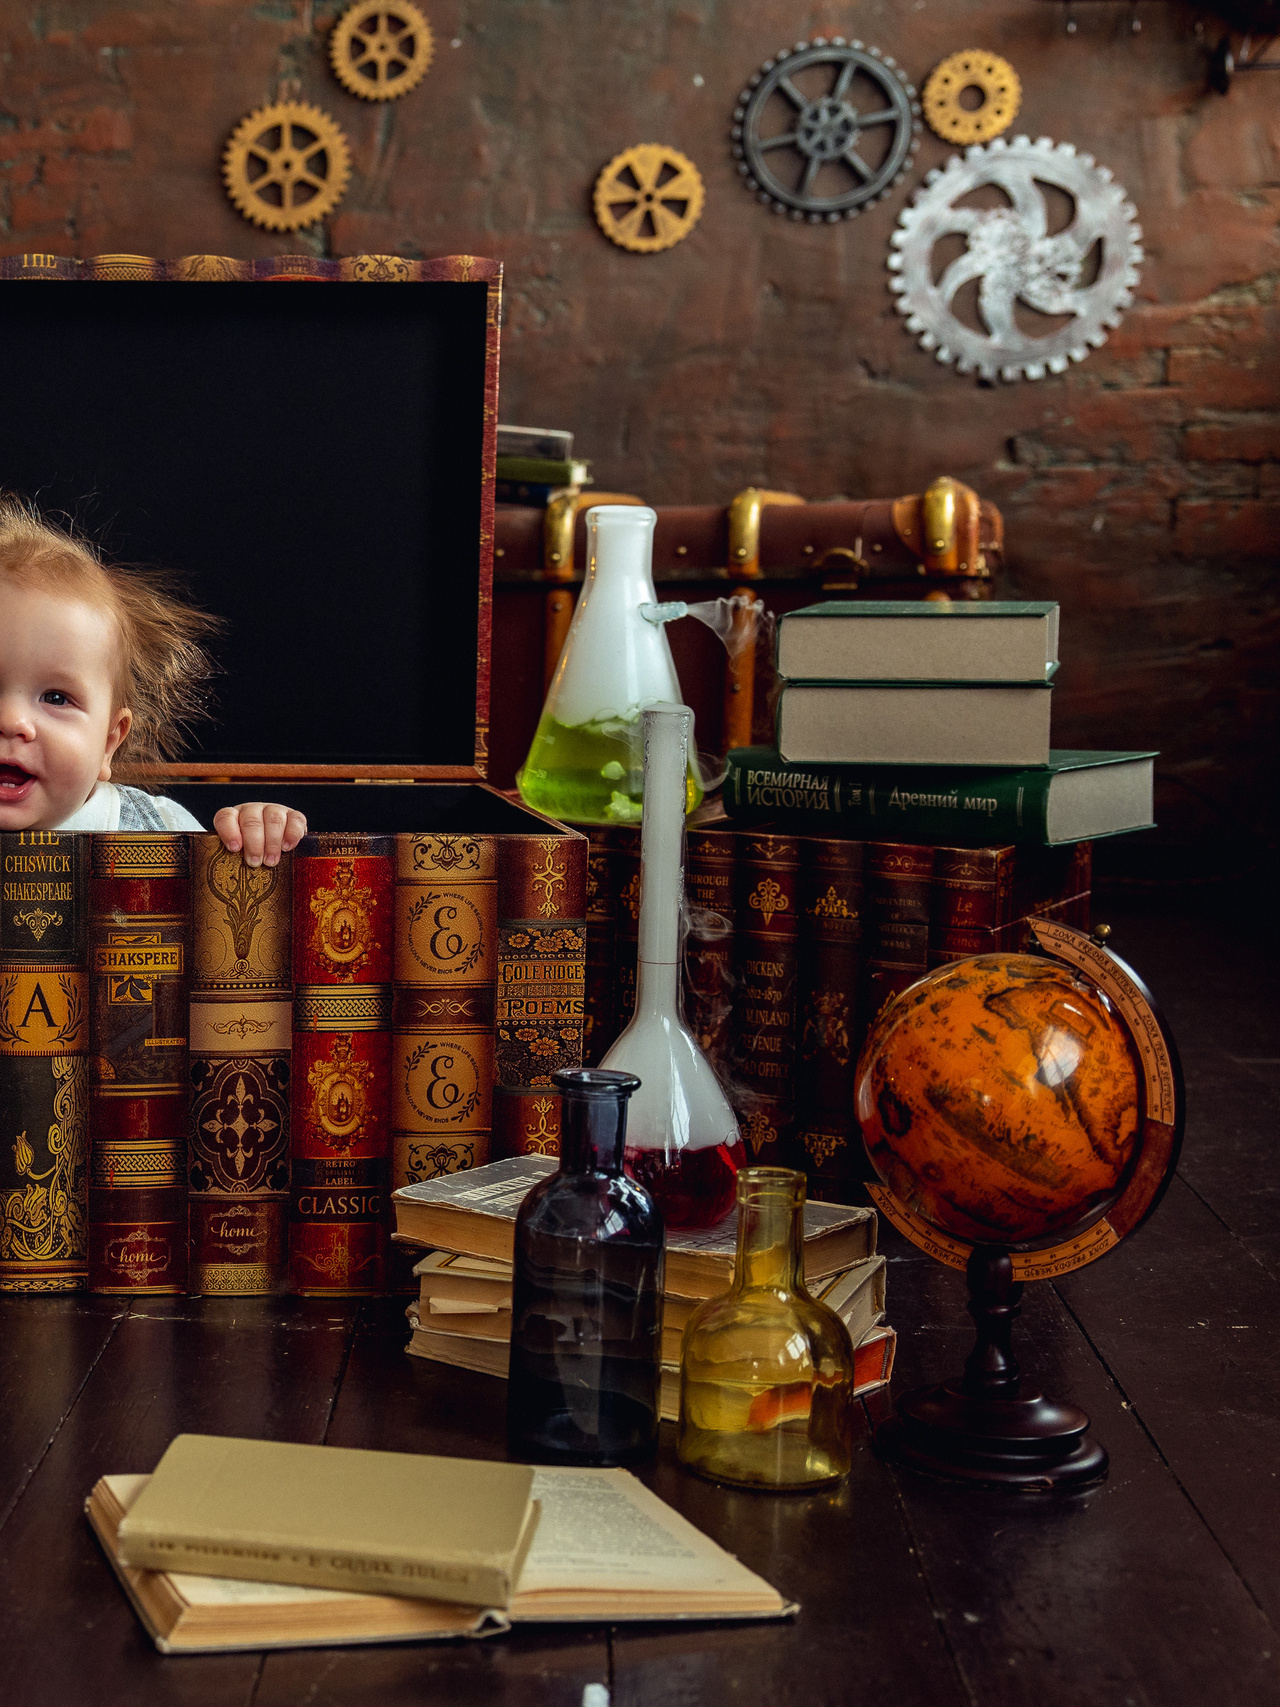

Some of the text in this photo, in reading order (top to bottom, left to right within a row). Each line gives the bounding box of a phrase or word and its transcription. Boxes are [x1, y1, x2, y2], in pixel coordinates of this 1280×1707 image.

[747, 770, 830, 790] ВСЕМИРНАЯ
[747, 786, 830, 810] ИСТОРИЯ
[888, 787, 998, 817] Древний мир
[329, 847, 360, 855] LABEL
[5, 855, 71, 872] CHISWICK
[4, 882, 73, 901] SHAKESPEARE
[98, 952, 178, 966] SHAKSPERE
[746, 960, 784, 978] DICKENS
[17, 983, 61, 1028] A
[504, 999, 584, 1017] POEMS
[440, 1042, 462, 1051] WHERE
[461, 1047, 472, 1059] LIFE
[325, 1178, 356, 1186] LABEL
[298, 1196, 380, 1215] CLASSIC
[211, 1221, 267, 1238] home
[111, 1247, 166, 1263] home
